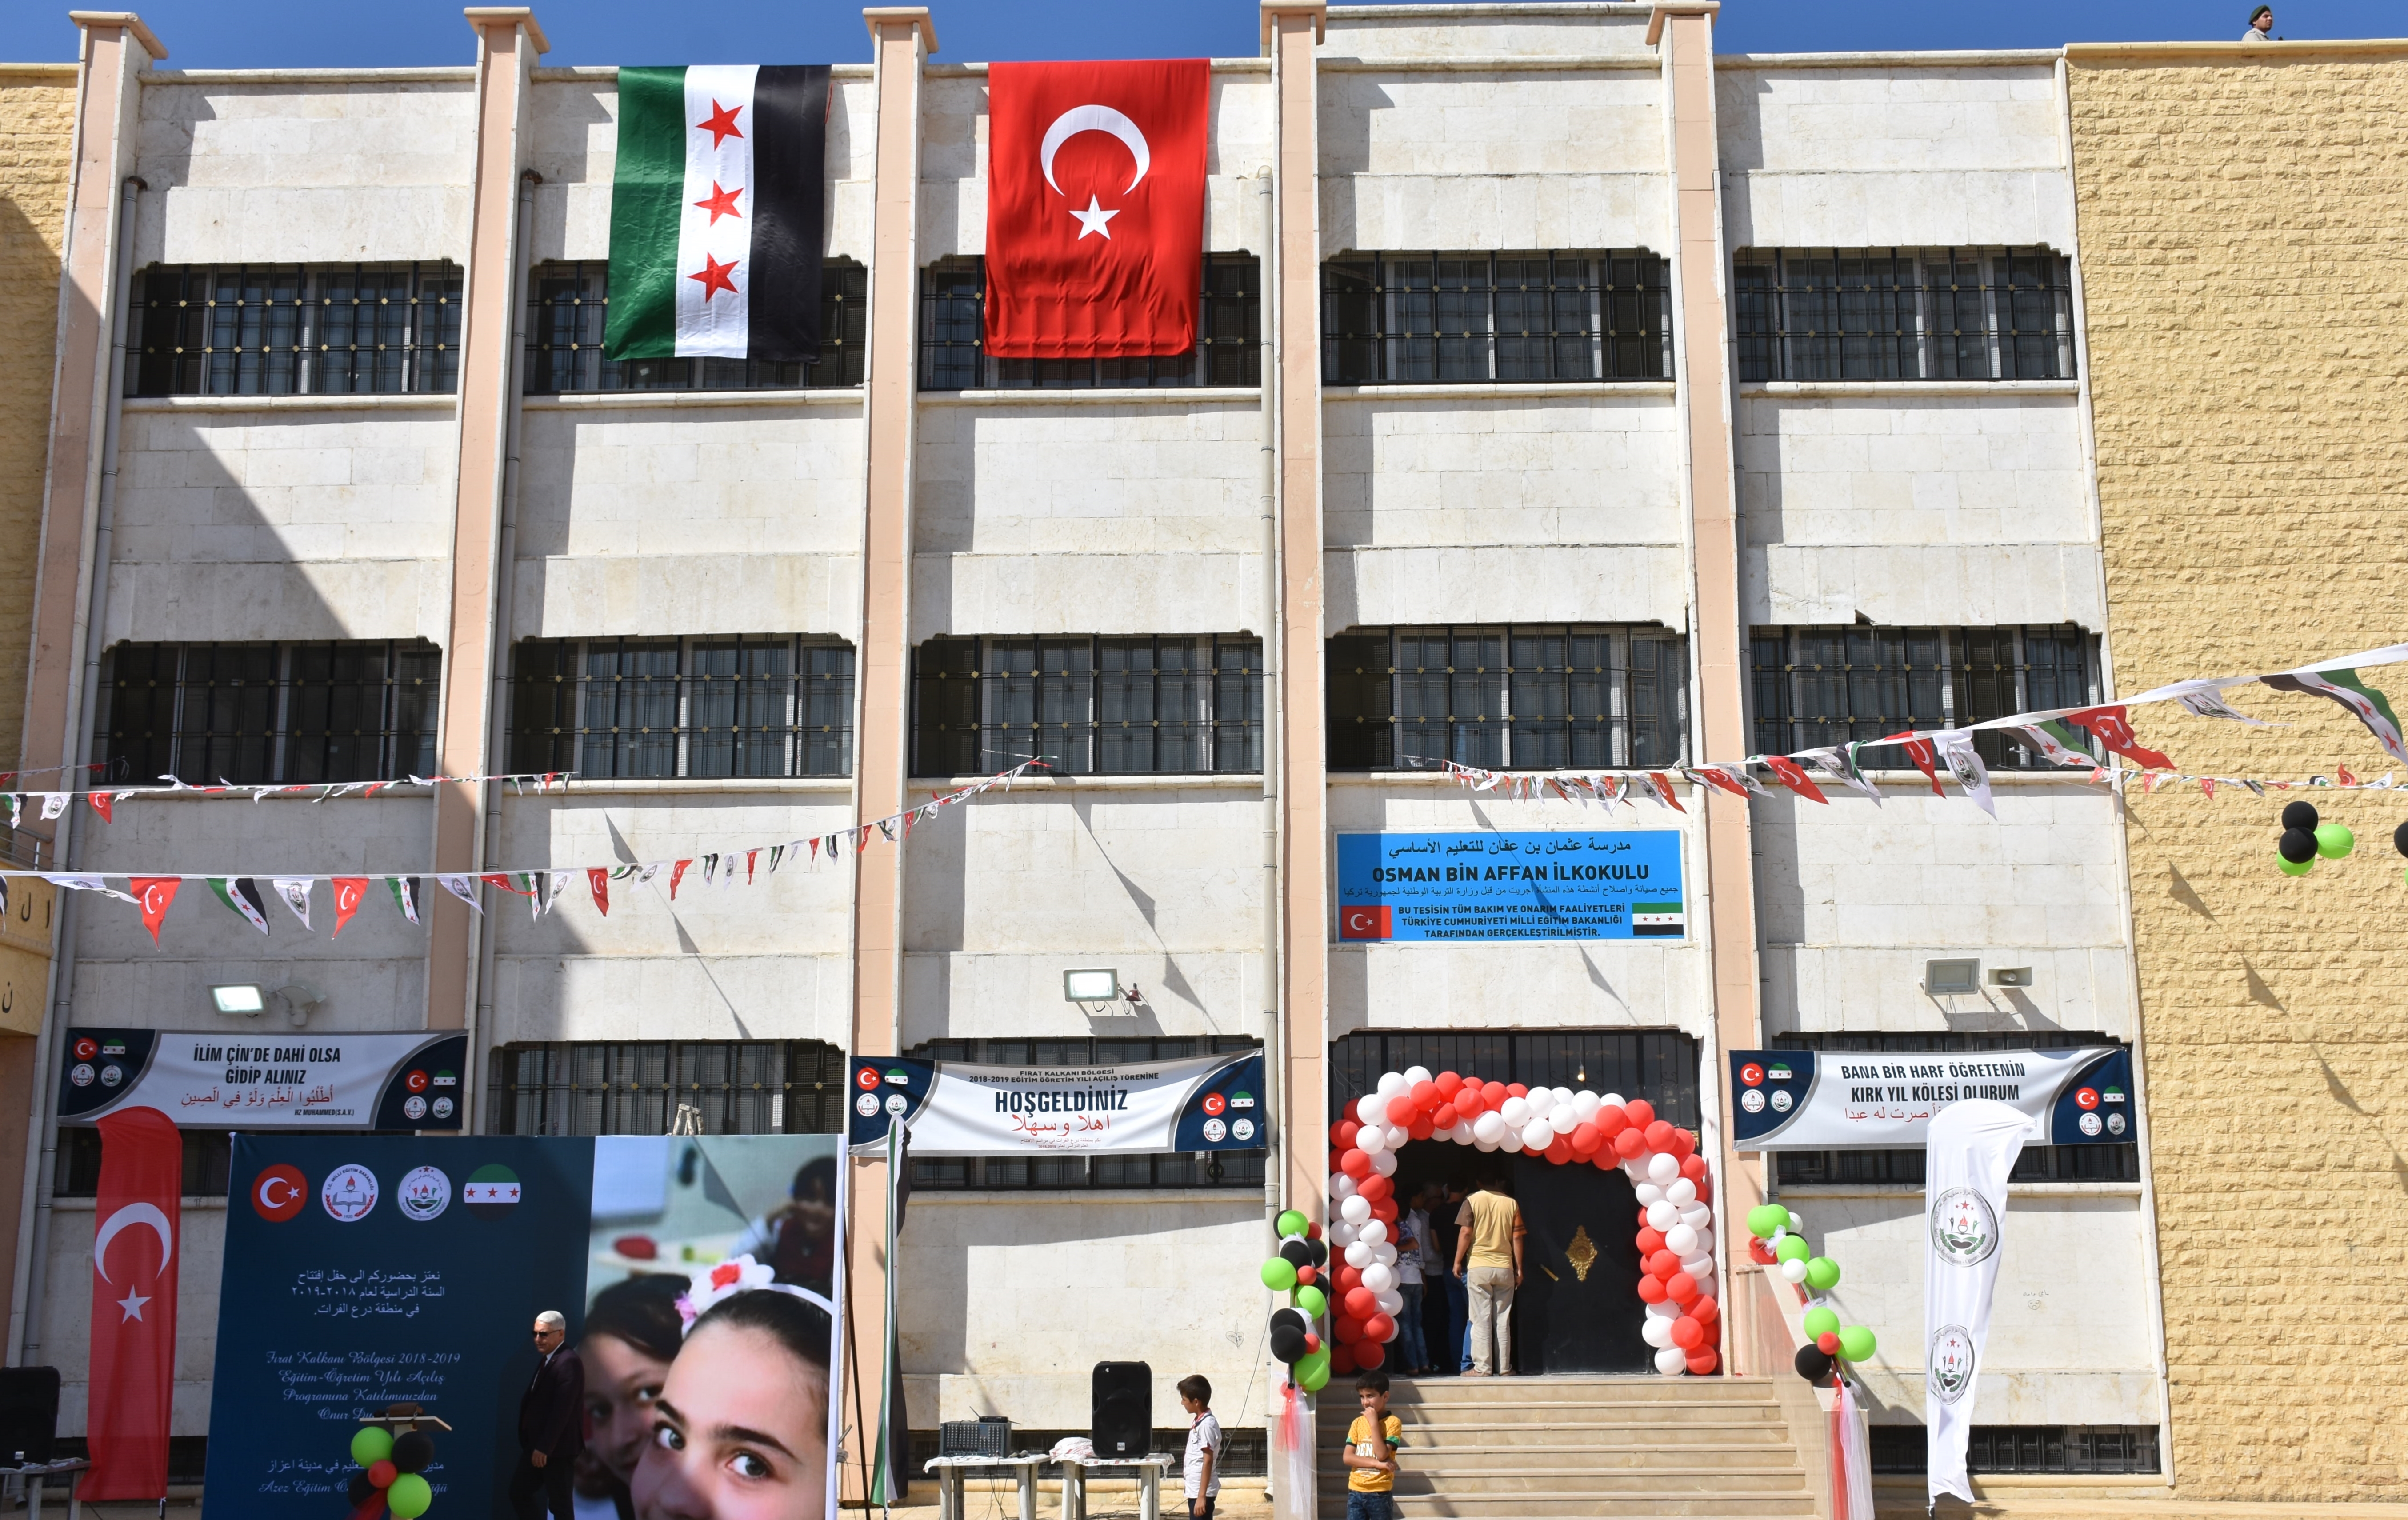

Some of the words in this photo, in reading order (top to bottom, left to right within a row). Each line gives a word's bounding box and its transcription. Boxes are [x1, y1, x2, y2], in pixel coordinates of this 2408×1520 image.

[1389, 838, 1440, 858] الأساسي
[1446, 840, 1484, 858] للتعليم
[1489, 840, 1518, 854] عفان
[1525, 840, 1540, 854] بن
[1546, 838, 1582, 854] عثمان
[1588, 837, 1631, 854] مدرسة
[1372, 867, 1440, 882] OSMAN
[1446, 862, 1478, 882] BİN
[1484, 865, 1548, 881] AFFAN
[1553, 861, 1649, 880] İLKOKULU
[1344, 887, 1363, 897] تركيا
[1365, 888, 1400, 897] لجمهورية
[1402, 887, 1428, 897] الوطنية
[1431, 887, 1453, 897] التربية
[1457, 887, 1478, 896] وزارة
[1481, 886, 1493, 896] قبل
[1496, 887, 1506, 896] من
[1562, 886, 1575, 894] هذه
[1577, 884, 1600, 894] أنشطة
[1635, 885, 1657, 895] صيانة
[1660, 886, 1679, 896] جميع
[1398, 906, 1411, 914] BU
[1413, 904, 1449, 914] TESİSİN
[1452, 904, 1472, 914] TÜM
[1474, 905, 1504, 913] BAKIM
[1520, 905, 1556, 913] ONARIM
[1560, 903, 1625, 912] FAALİYETLERİ
[1402, 916, 1441, 926] TÜRKİYE
[1444, 916, 1508, 925] CUMHURİYETİ
[1510, 915, 1535, 925] MİLLİ
[1537, 914, 1569, 924] EĞİTİM
[1572, 914, 1622, 924] BAKANLIĞI
[1424, 929, 1484, 938] TARAFINDAN
[1487, 927, 1600, 937] GERÇEKLEŞTİRİLMİŞTİR.
[193, 1044, 222, 1061] İLİM
[274, 1045, 305, 1062] DAHİ
[309, 1048, 340, 1062] OLSA
[225, 1066, 261, 1084] GİDİP
[264, 1069, 307, 1084] ALINIZ
[1841, 1065, 1880, 1079] BANA
[1883, 1063, 1906, 1079] BİR
[1910, 1065, 1945, 1078] HARF
[1949, 1060, 2025, 1078] ÖĞRETENİN
[1120, 1072, 1159, 1081] TÖRENİNE
[1852, 1087, 1884, 1102] KIRK
[1887, 1086, 1908, 1102] YIL
[1912, 1082, 1958, 1102] KÖLESİ
[1964, 1085, 2019, 1100] OLURUM
[996, 1085, 1128, 1118] HOŞGELDİNİZ
[1844, 1108, 1868, 1123] عبدا
[1873, 1106, 1885, 1119] له
[1890, 1108, 1928, 1123] صرت
[1012, 1114, 1056, 1136] سهلا
[1078, 1114, 1110, 1131] اهلا
[298, 1270, 324, 1284] إفتتاح
[327, 1270, 347, 1281] حفل
[349, 1270, 364, 1283] الى
[368, 1270, 416, 1284] بحضوركم
[420, 1271, 440, 1283] نعتز
[359, 1287, 377, 1300] لعام
[380, 1286, 418, 1299] الدراسية
[422, 1286, 444, 1296] السنة
[351, 1306, 372, 1318] درع
[375, 1303, 403, 1313] منطقة
[405, 1303, 420, 1317] في
[266, 1351, 294, 1364] Fırat
[297, 1352, 346, 1364] Kalkanı
[349, 1351, 396, 1368] Bölgesi
[375, 1370, 402, 1386] Yılı
[406, 1370, 444, 1385] Açılış
[284, 1389, 349, 1405] Programına
[353, 1389, 439, 1401] Katılımınızdan
[318, 1408, 350, 1420] Onur
[267, 1460, 294, 1472] اعزاز
[298, 1460, 322, 1471] مدينة
[325, 1460, 339, 1474] في
[258, 1480, 290, 1492] Azez
[293, 1480, 332, 1496] Eğitim
